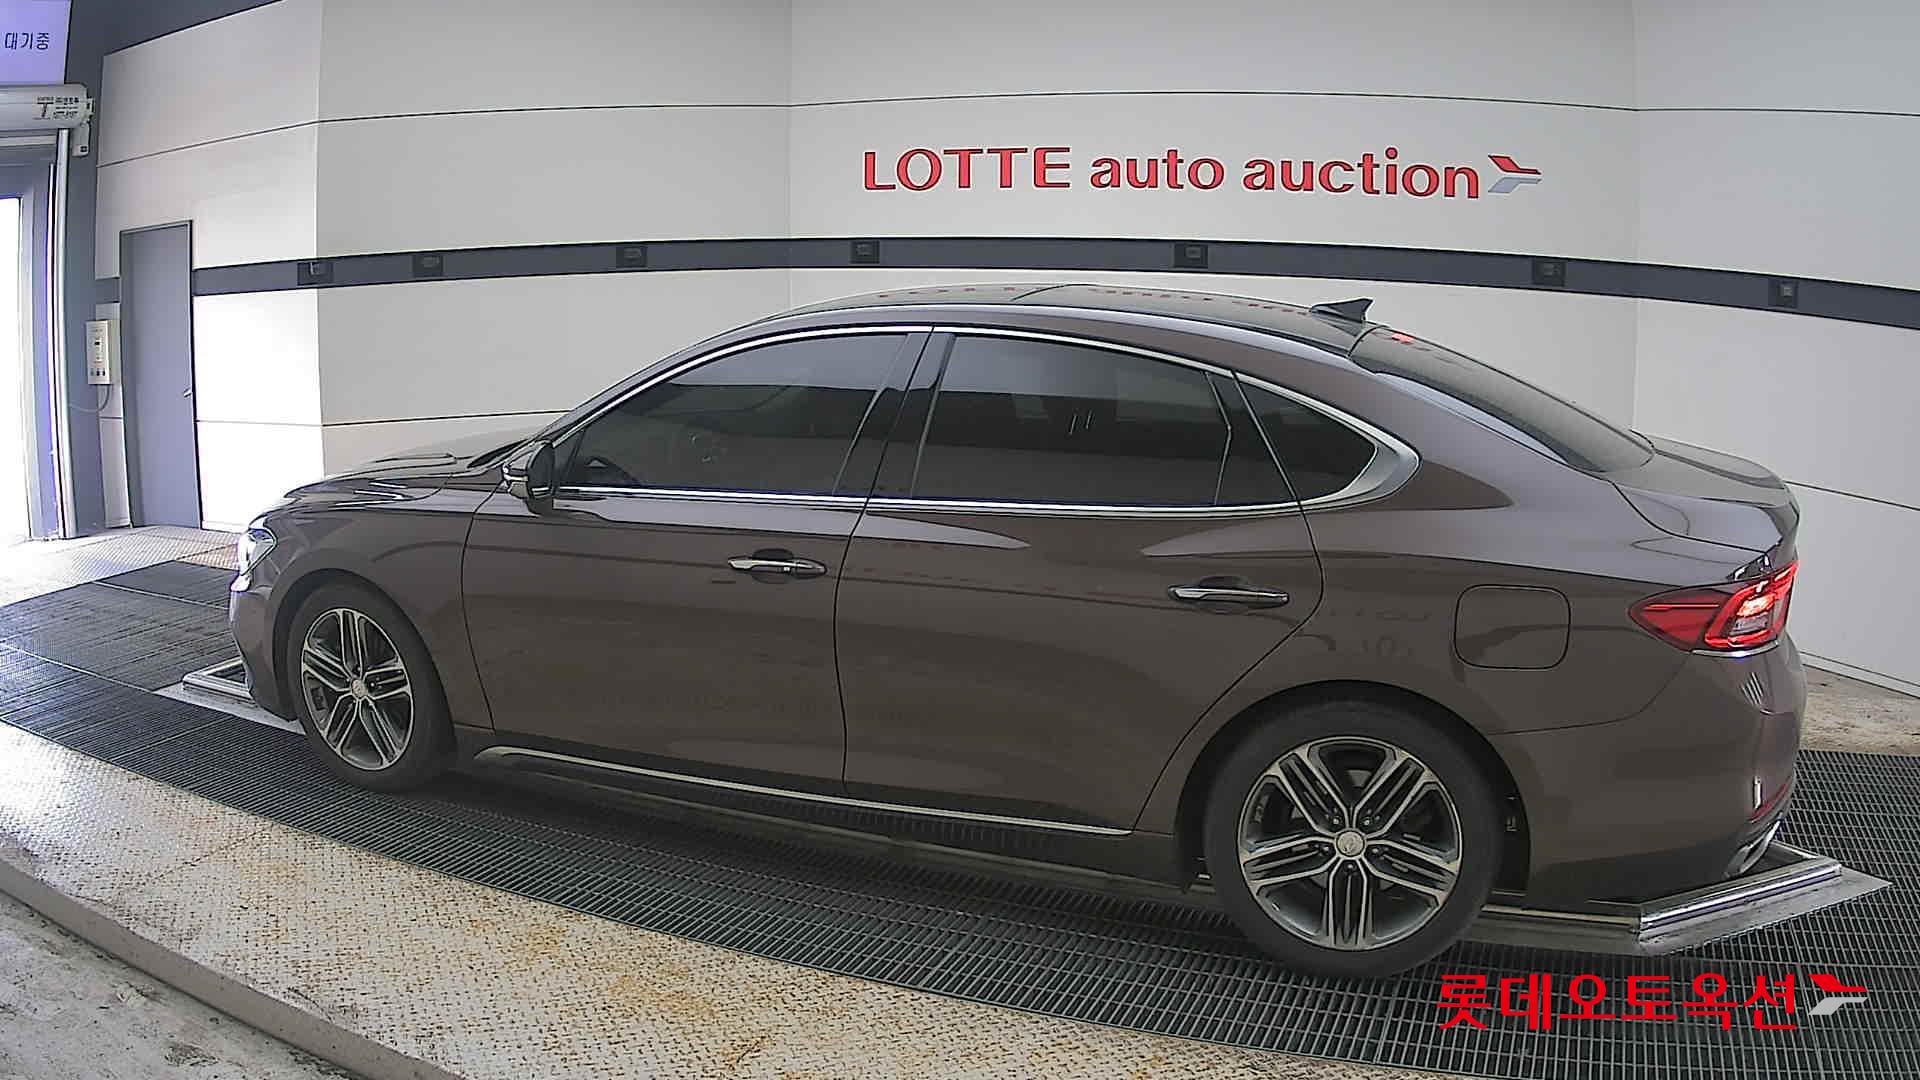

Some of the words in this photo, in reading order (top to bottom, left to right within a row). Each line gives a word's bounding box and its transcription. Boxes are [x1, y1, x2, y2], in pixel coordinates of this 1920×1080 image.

[4, 32, 50, 50] 대기중
[864, 147, 1071, 191] LOTTE
[1090, 149, 1225, 190] auto
[1243, 147, 1480, 198] auction
